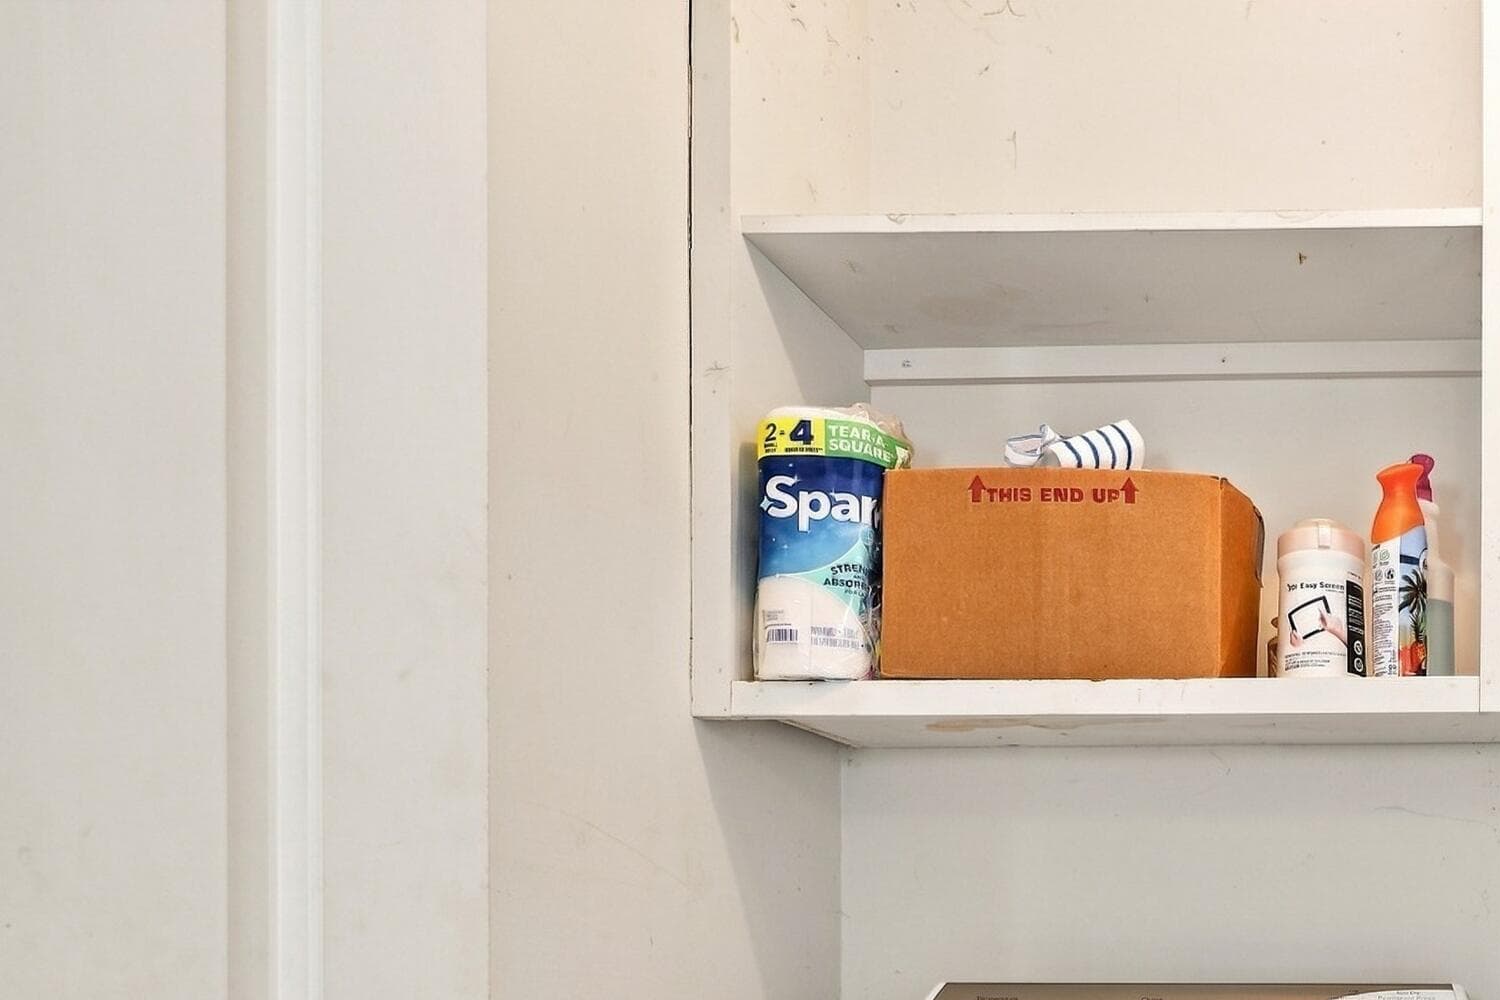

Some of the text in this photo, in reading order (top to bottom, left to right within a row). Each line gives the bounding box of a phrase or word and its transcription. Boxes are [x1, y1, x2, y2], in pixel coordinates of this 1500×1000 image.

[766, 423, 777, 442] 2
[790, 419, 814, 445] 4
[828, 440, 892, 463] SQUARE
[766, 475, 881, 532] Spar
[987, 488, 1120, 503] THIS END UP
